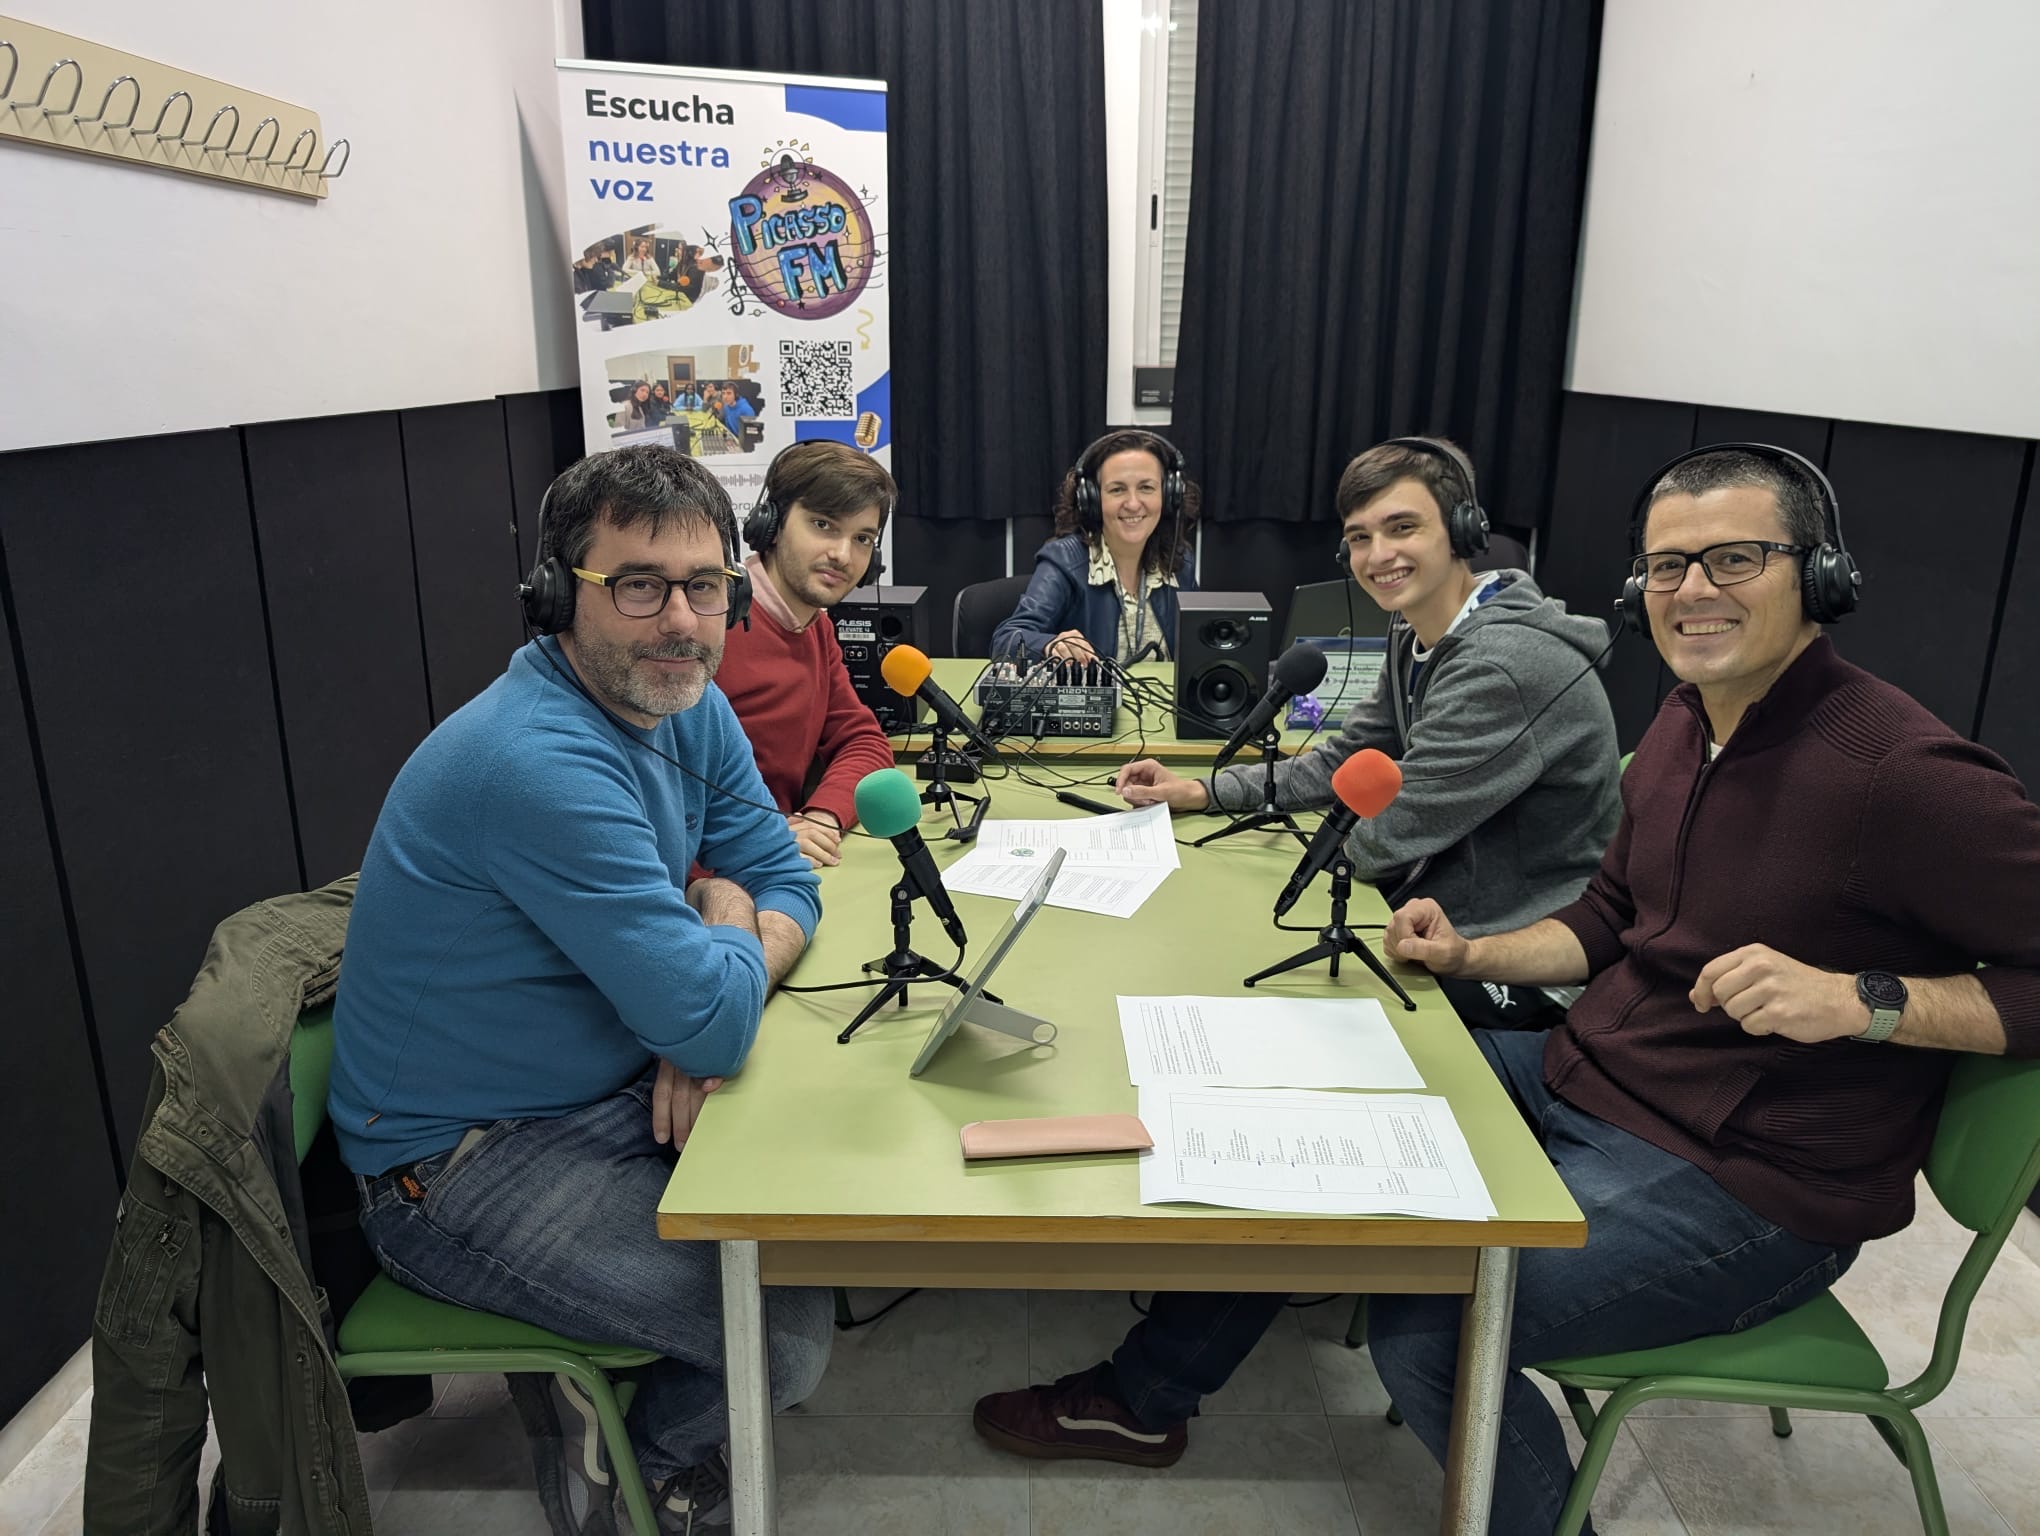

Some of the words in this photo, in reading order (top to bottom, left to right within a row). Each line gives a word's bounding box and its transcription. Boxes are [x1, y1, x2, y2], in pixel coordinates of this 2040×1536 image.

[585, 89, 735, 125] Escucha
[589, 139, 730, 168] nuestra
[590, 178, 654, 201] voz
[777, 239, 847, 301] FM
[836, 619, 872, 627] ALESIS
